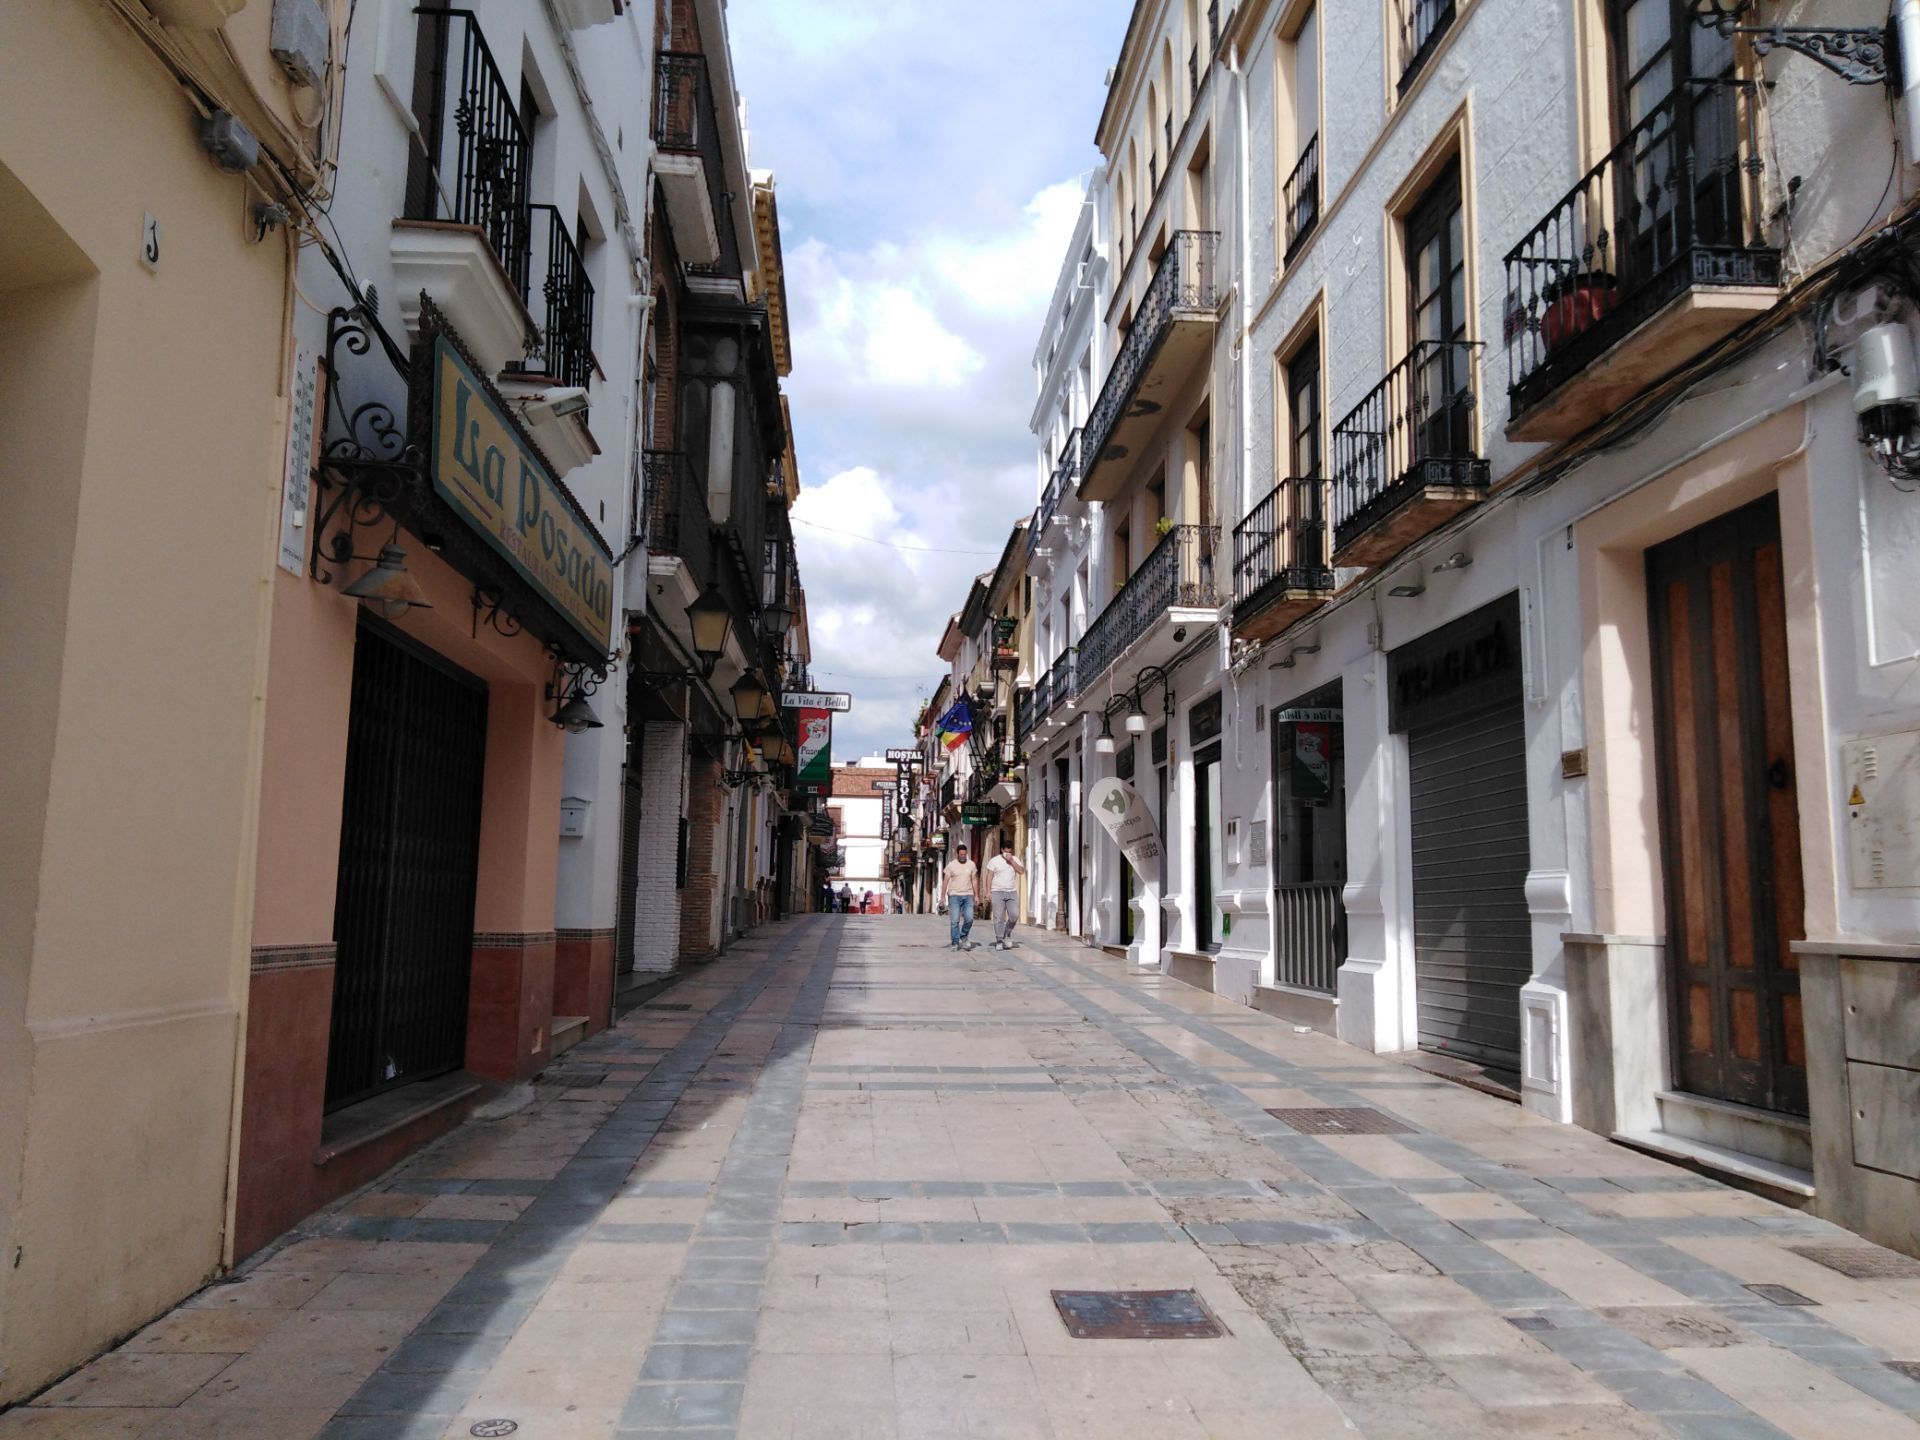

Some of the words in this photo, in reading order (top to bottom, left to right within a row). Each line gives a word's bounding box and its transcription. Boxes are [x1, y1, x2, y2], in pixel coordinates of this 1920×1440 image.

[453, 377, 506, 511] La
[516, 453, 608, 621] Posada
[783, 695, 795, 705] La
[798, 695, 814, 705] Vita
[824, 697, 846, 707] Bella
[887, 750, 923, 760] HOSTAL
